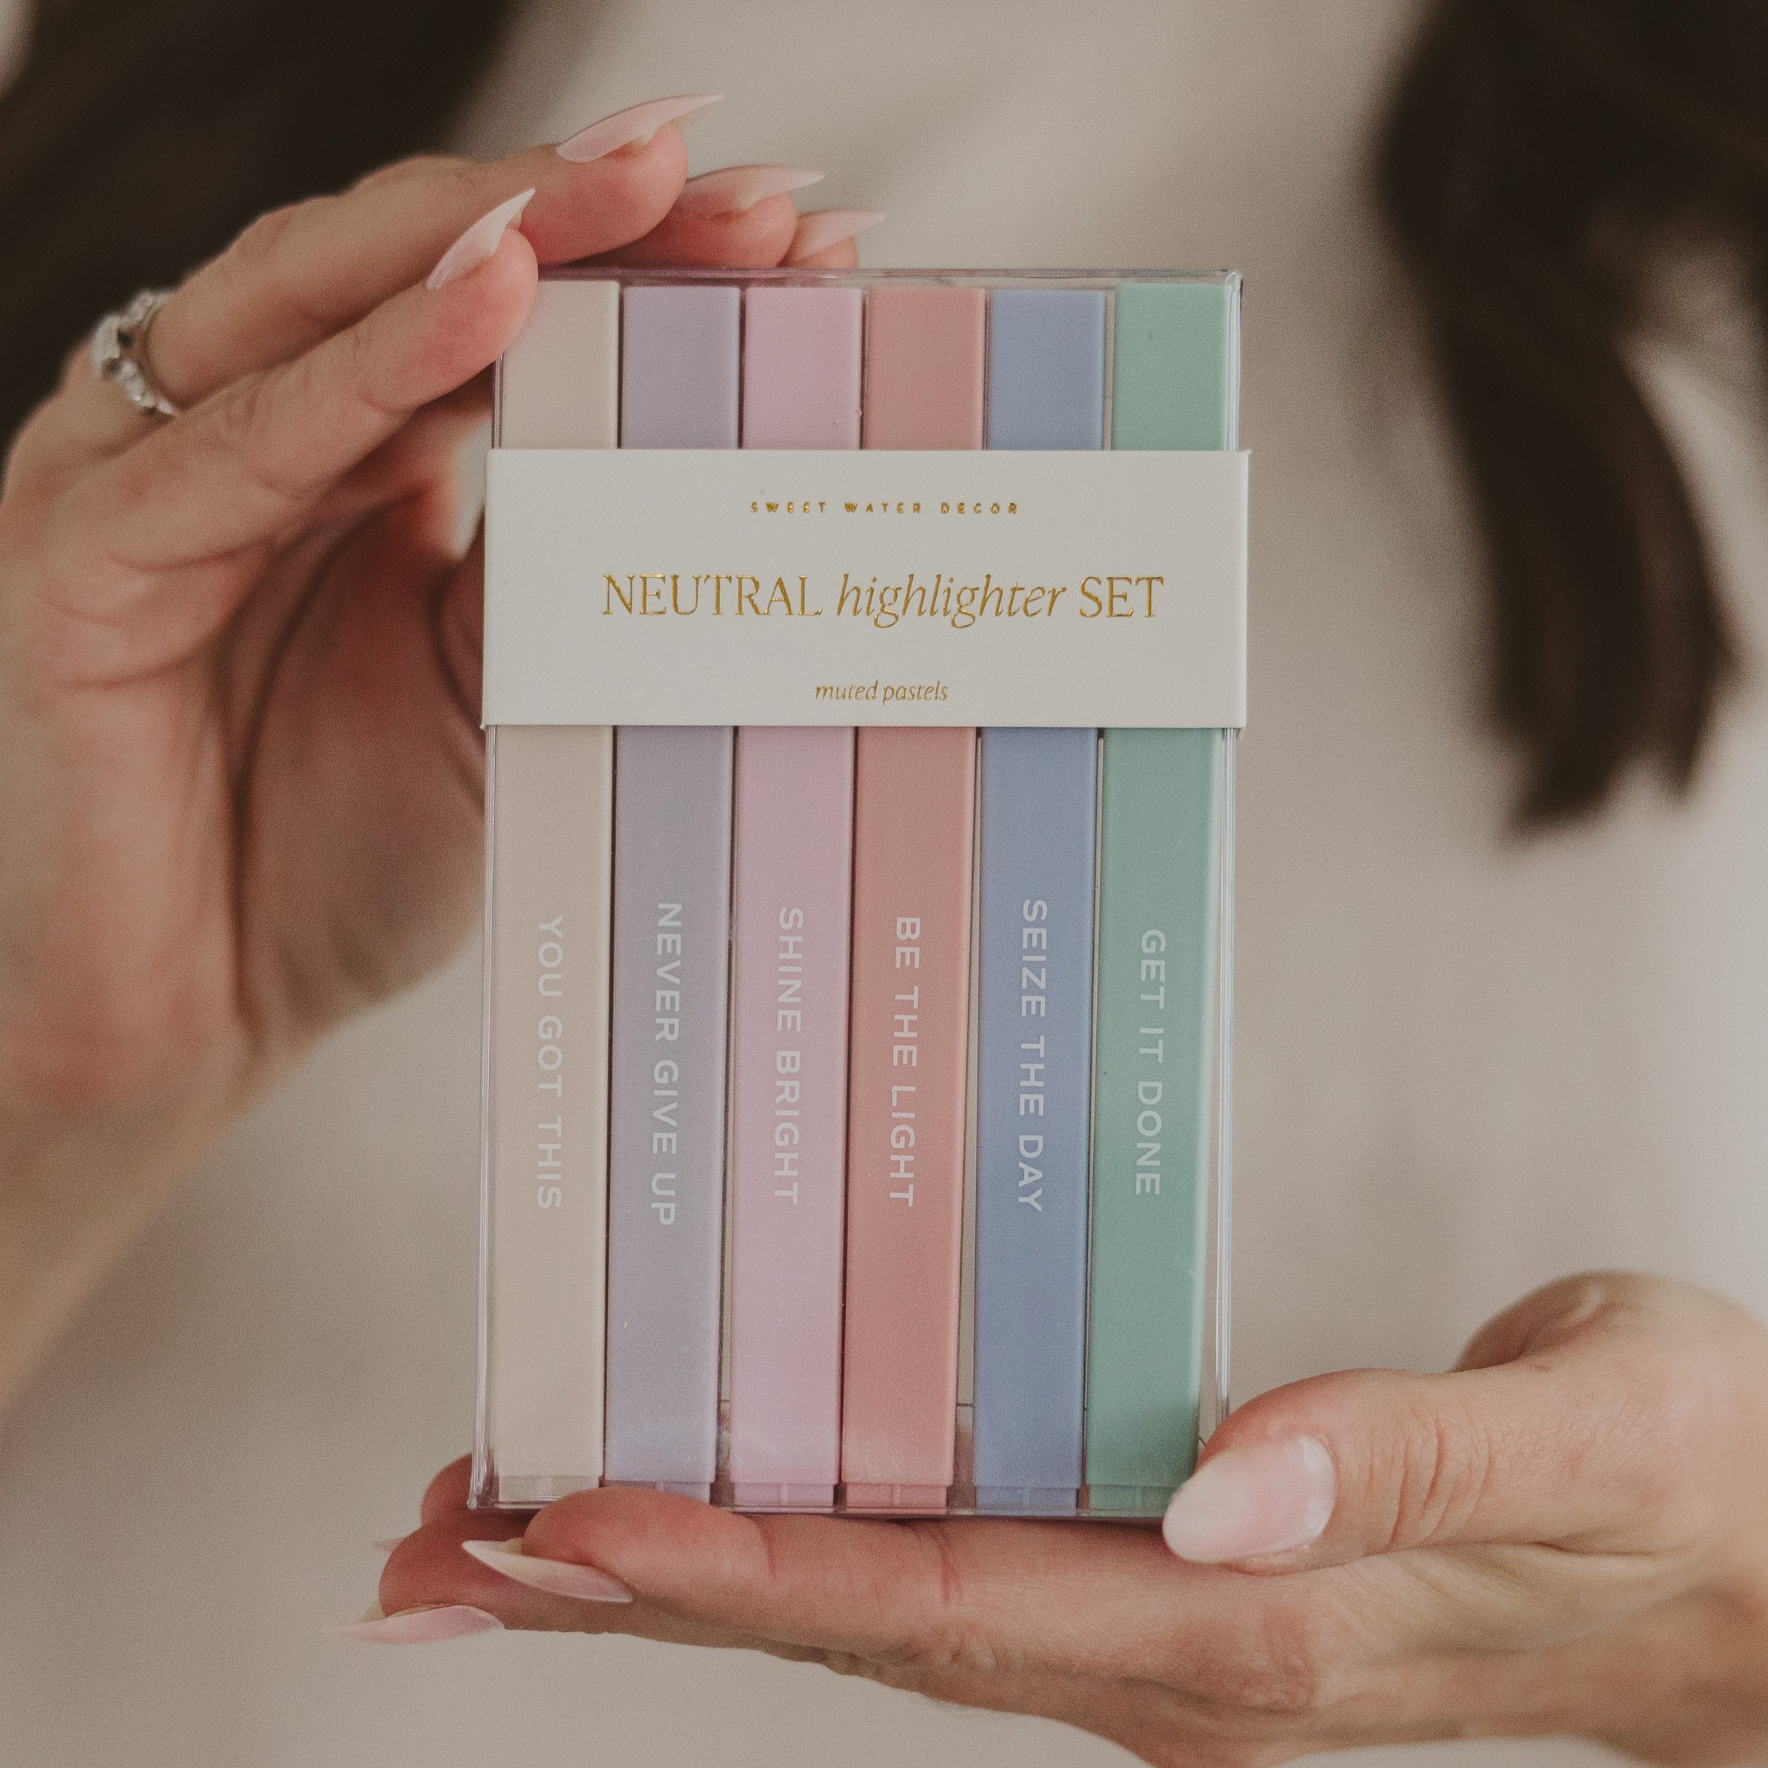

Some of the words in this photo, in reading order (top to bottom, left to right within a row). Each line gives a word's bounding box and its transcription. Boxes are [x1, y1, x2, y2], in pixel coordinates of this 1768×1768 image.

[751, 502, 827, 514] SWEET
[844, 502, 922, 514] WATER
[941, 502, 1019, 514] DECOR
[603, 573, 822, 617] NEUTRAL
[836, 573, 1066, 629] highlighter
[1080, 575, 1164, 619] SET
[815, 681, 878, 702] muted
[882, 681, 948, 704] pastels
[538, 915, 563, 997] YOU
[655, 902, 682, 1042] NEVER
[777, 907, 804, 1032] SHINE
[895, 916, 920, 969] BE
[1021, 899, 1048, 1017] SEIZE
[1139, 929, 1166, 1009] GET
[537, 1015, 563, 1098] GOT
[892, 986, 919, 1067] THE
[1138, 1027, 1164, 1063] IT
[652, 1059, 679, 1155] GIVE
[1019, 1035, 1045, 1116] THE
[536, 1116, 563, 1209] THIS
[773, 1050, 800, 1206] BRIGHT
[889, 1085, 916, 1207] LIGHT
[1135, 1081, 1162, 1196] DONE
[651, 1172, 677, 1225] UP
[1017, 1134, 1043, 1212] DAY
